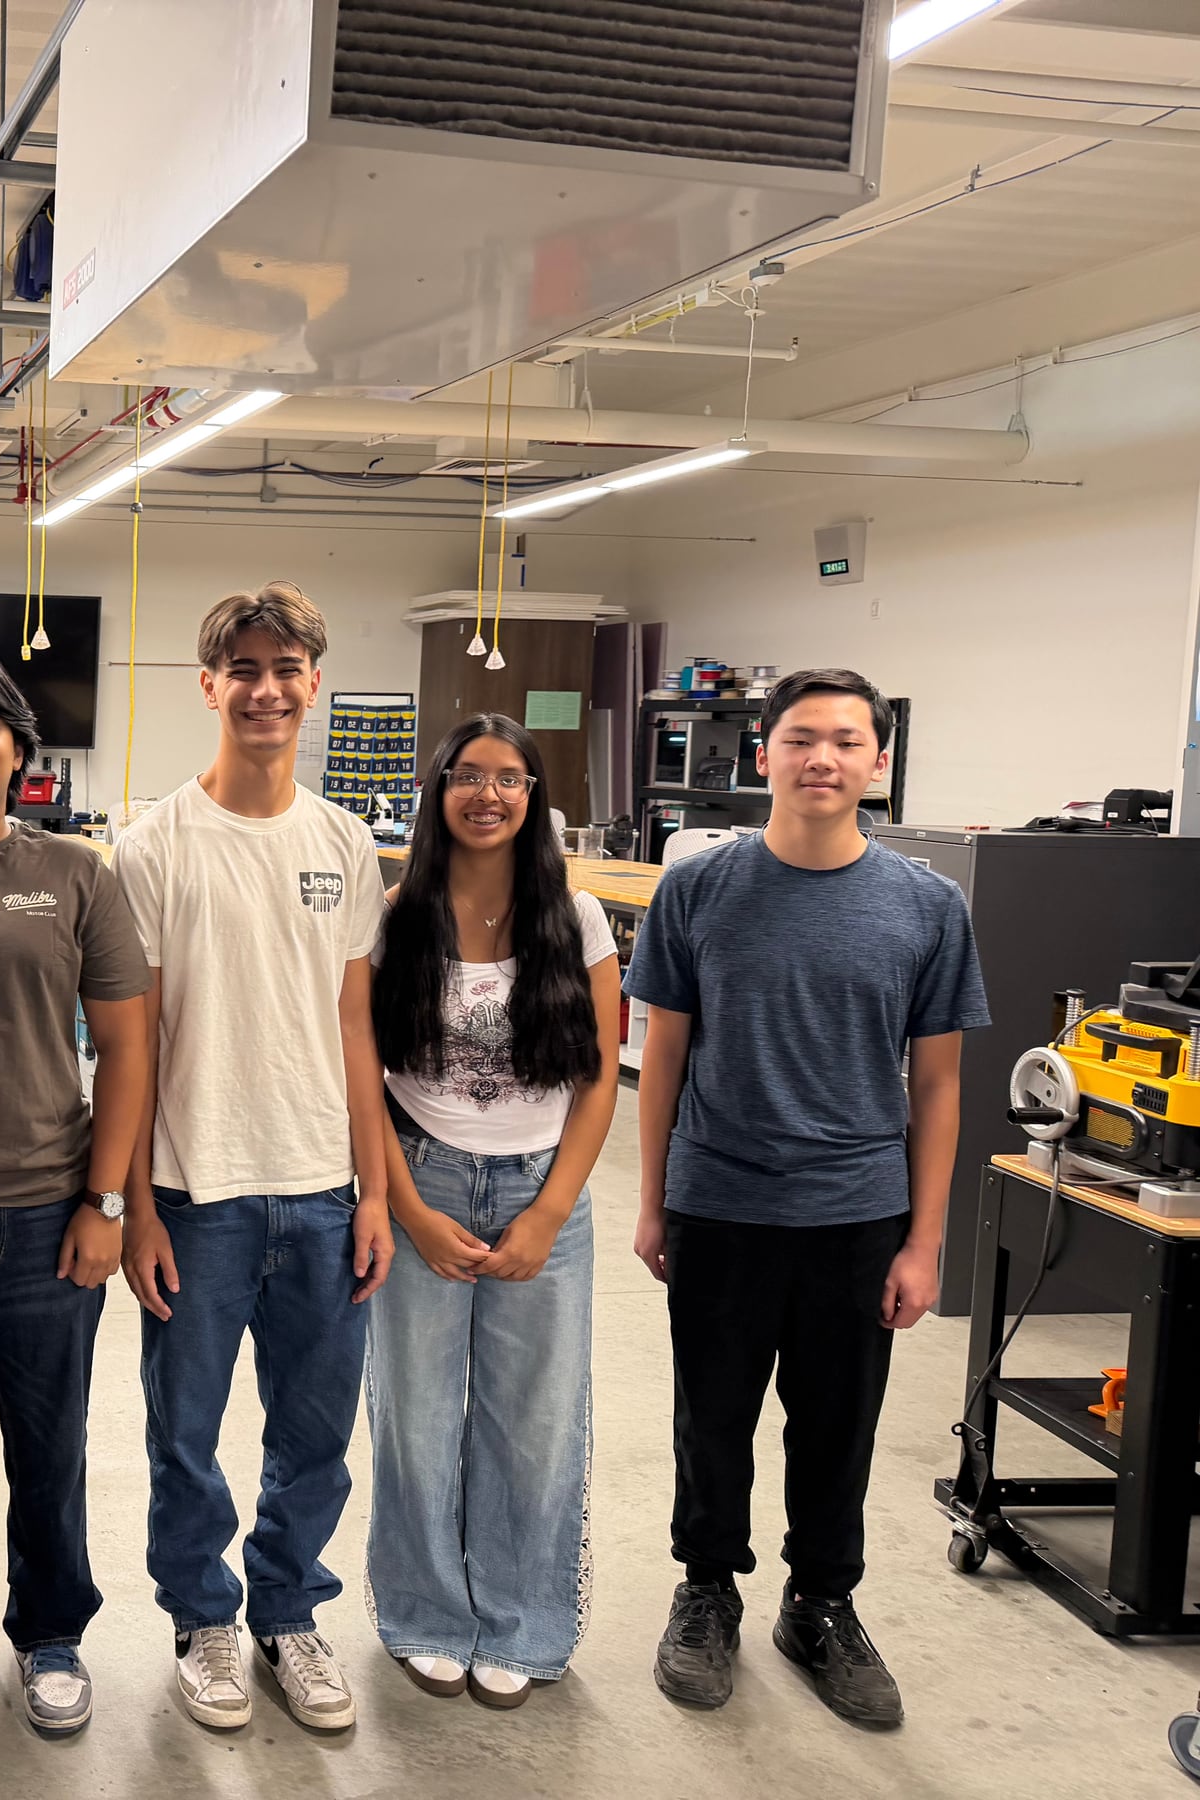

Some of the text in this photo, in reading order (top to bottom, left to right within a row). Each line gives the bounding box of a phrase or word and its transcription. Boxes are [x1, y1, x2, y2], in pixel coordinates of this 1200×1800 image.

[333, 720, 343, 728] 01
[347, 721, 357, 729] 02
[362, 722, 371, 730] 03
[390, 721, 399, 729] 05
[403, 721, 412, 729] 06
[332, 740, 341, 748] 07
[345, 741, 355, 749] 08
[402, 742, 411, 750] 12
[330, 760, 340, 768] 13
[359, 763, 368, 771] 15
[375, 763, 383, 771] 16
[388, 763, 397, 771] 17
[402, 762, 411, 770] 18
[330, 780, 339, 788] 19
[343, 782, 353, 790] 20
[357, 783, 366, 791] 21
[386, 782, 395, 790] 23
[401, 783, 411, 791] 24
[400, 803, 409, 811] 30
[302, 873, 341, 894] Jeep
[2, 891, 57, 910] Malibu
